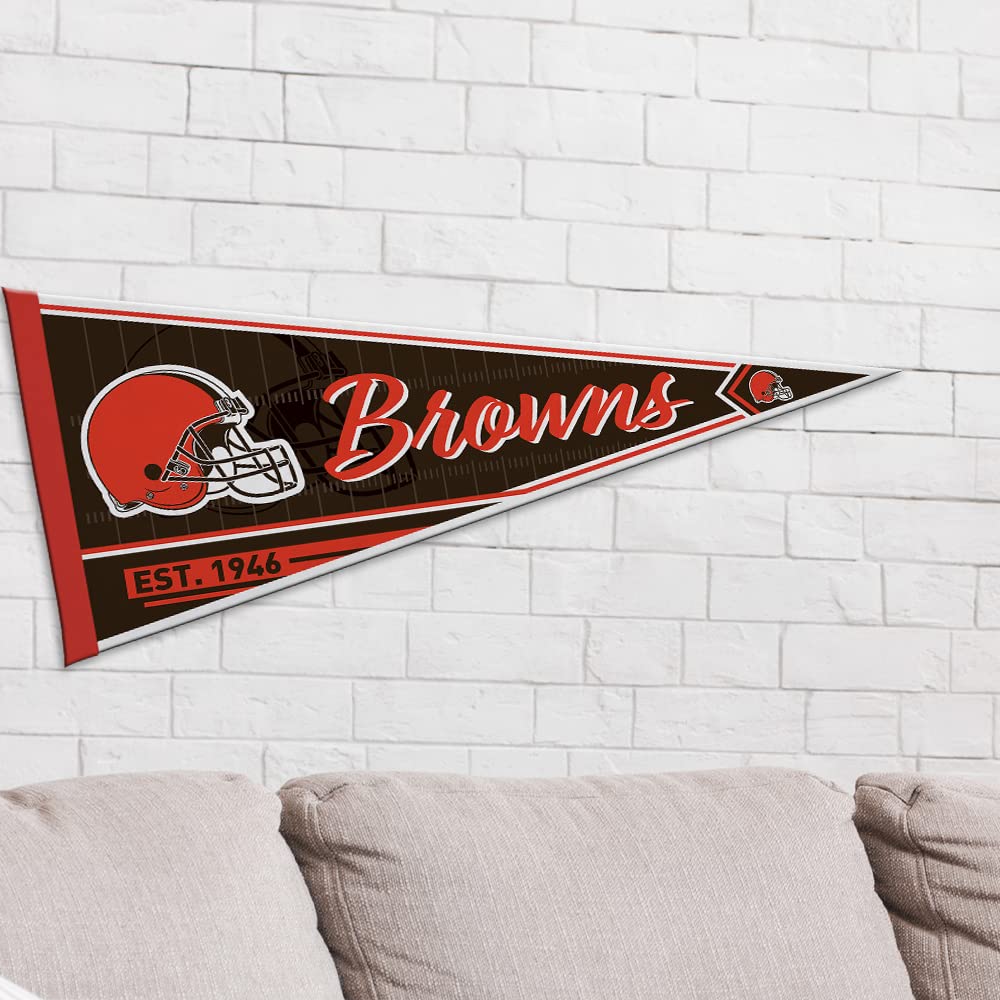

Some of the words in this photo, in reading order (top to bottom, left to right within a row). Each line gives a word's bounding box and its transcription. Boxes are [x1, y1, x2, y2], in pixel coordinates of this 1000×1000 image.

[323, 371, 694, 483] Browns
[133, 564, 203, 594] EST.
[211, 552, 281, 582] 1946
